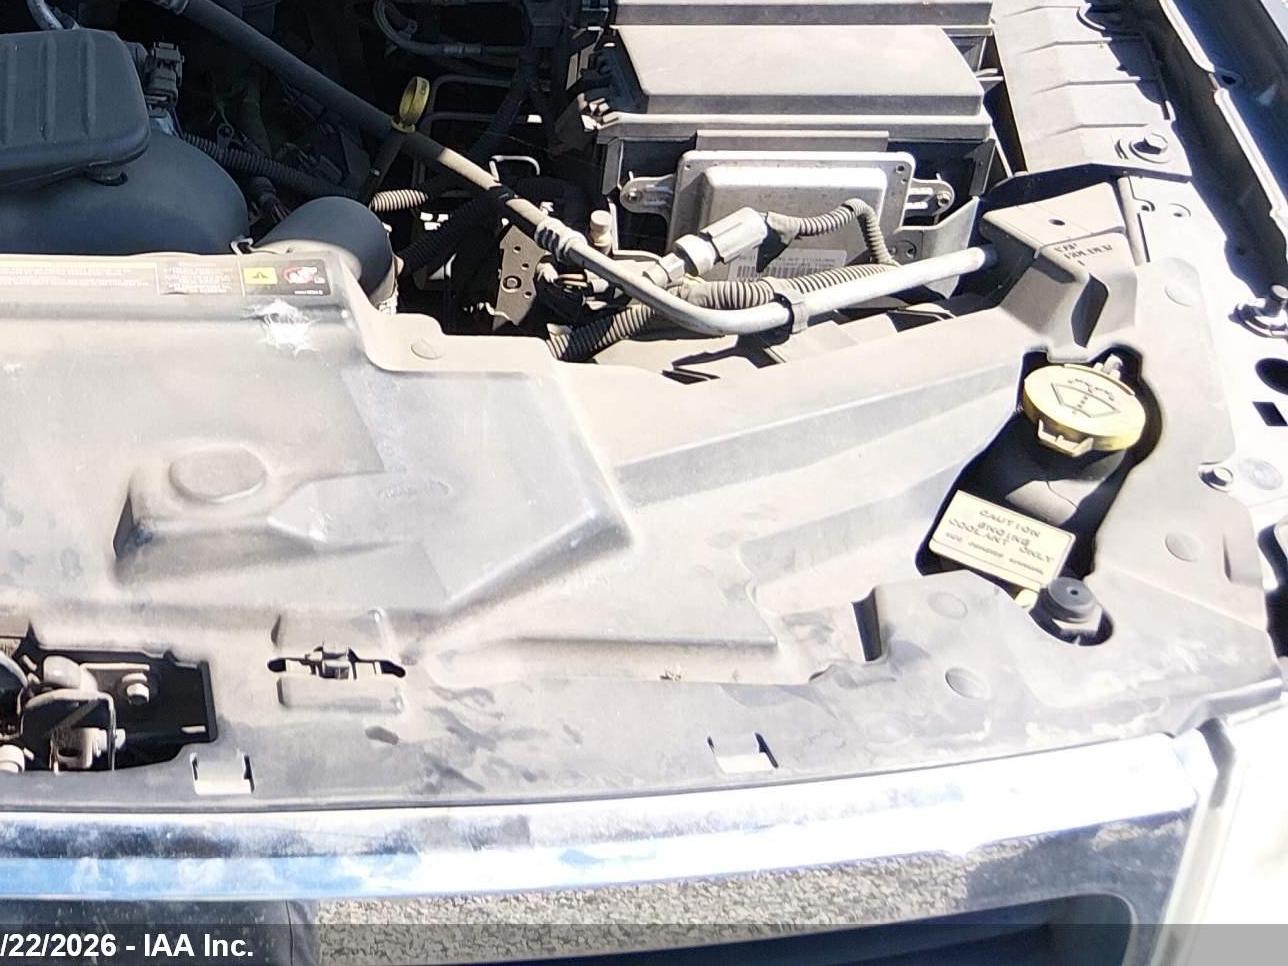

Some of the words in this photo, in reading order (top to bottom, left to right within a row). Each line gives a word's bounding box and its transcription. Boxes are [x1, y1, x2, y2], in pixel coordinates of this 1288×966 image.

[948, 517, 1011, 546] COOLANT
[1018, 545, 1055, 563] ONLY
[978, 509, 1041, 538] CAUTION
